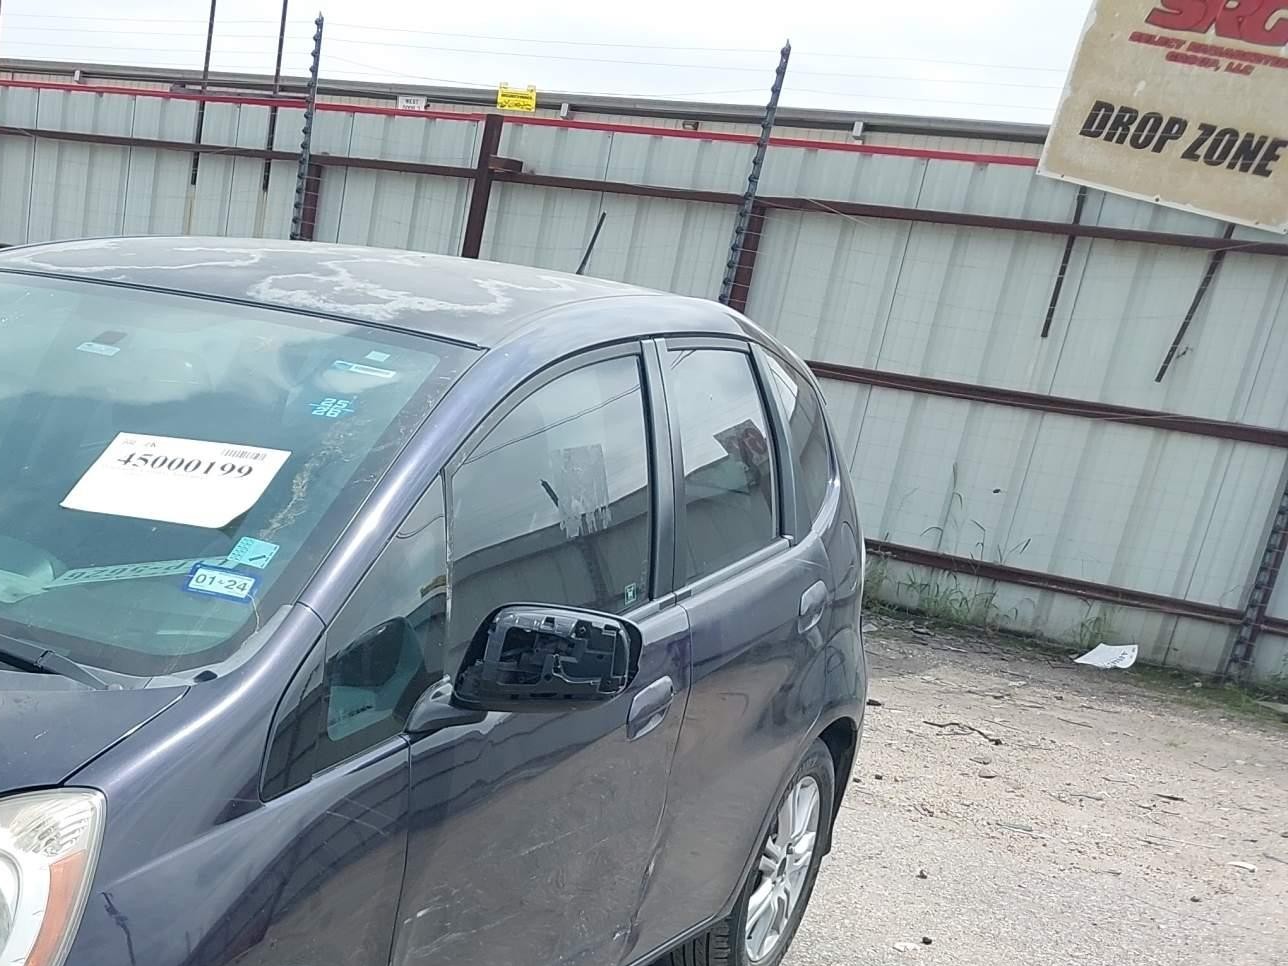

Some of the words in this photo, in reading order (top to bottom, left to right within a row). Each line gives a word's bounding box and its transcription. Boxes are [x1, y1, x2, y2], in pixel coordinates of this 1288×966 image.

[1079, 100, 1188, 153] DROP
[1180, 123, 1288, 178] ZONE
[117, 452, 254, 479] 45000199
